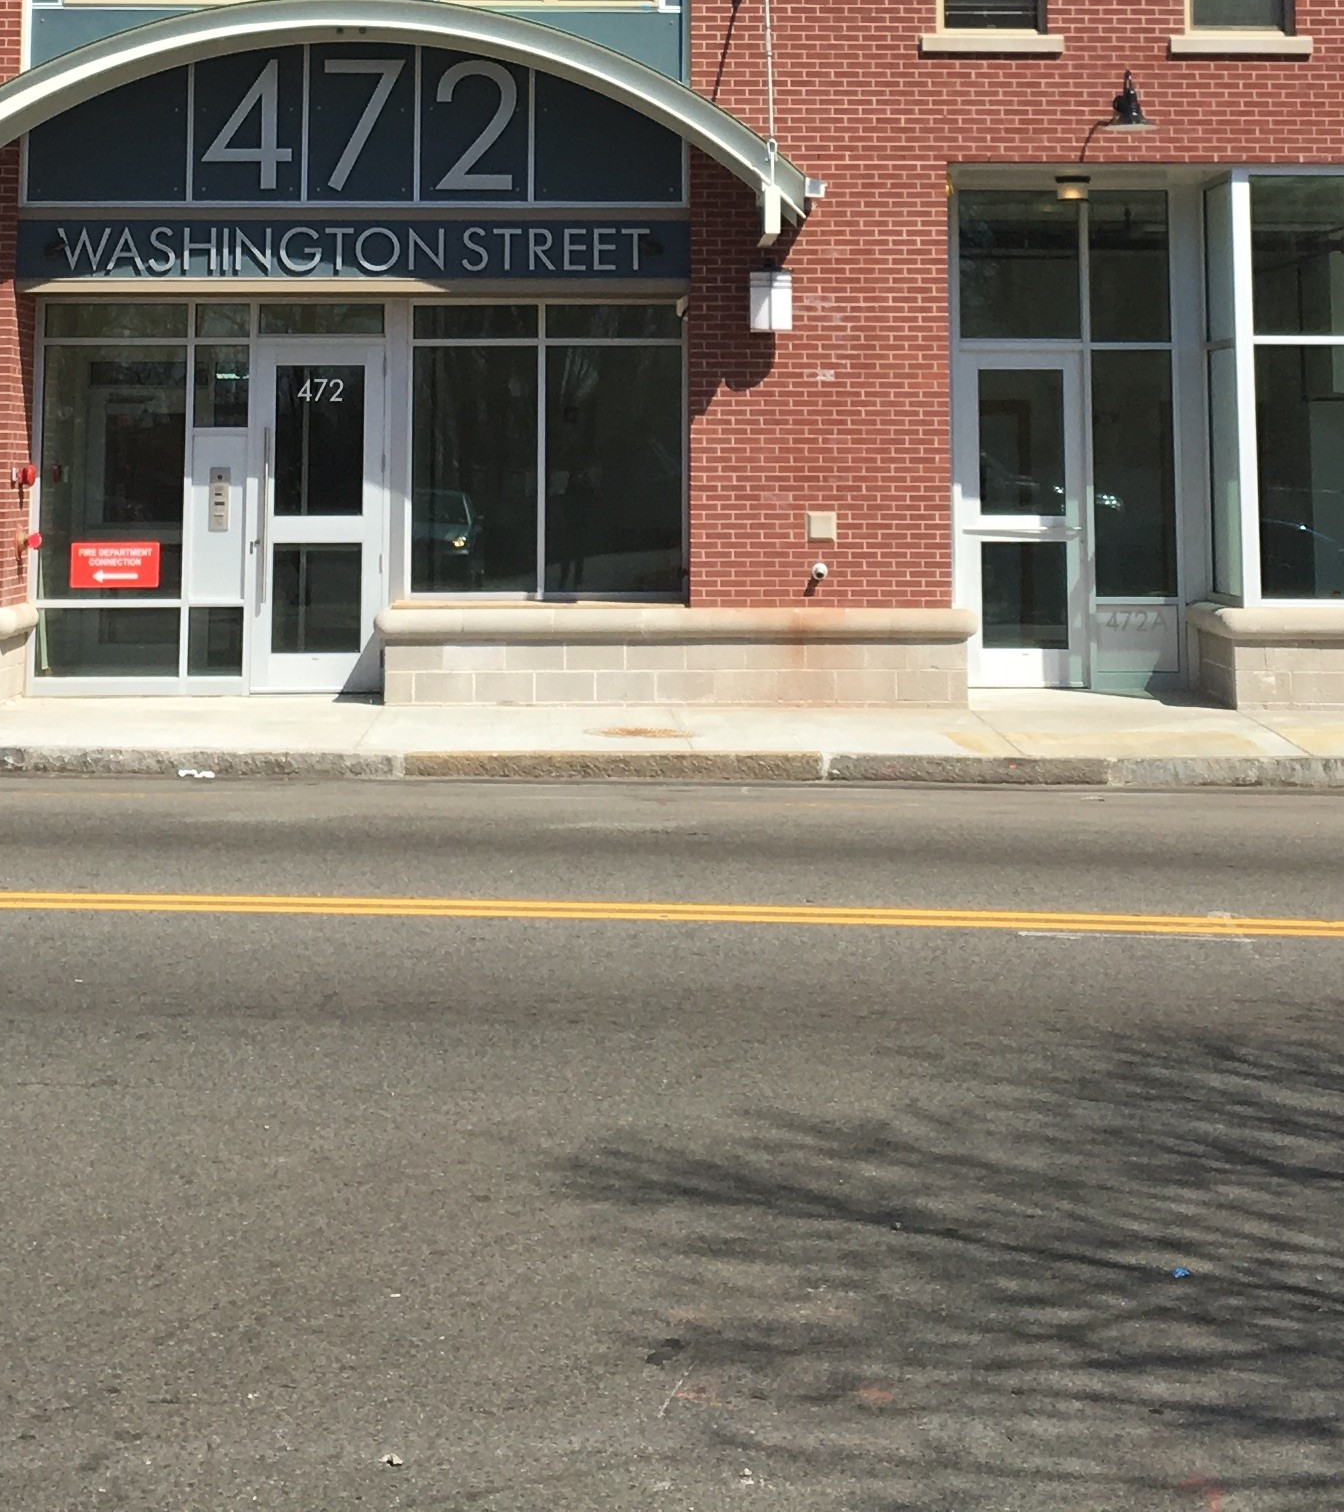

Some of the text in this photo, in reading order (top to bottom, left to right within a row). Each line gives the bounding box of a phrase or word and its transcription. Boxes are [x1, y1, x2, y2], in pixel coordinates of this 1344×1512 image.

[201, 59, 518, 192] 472
[57, 226, 650, 273] WASHINGTON STREET
[297, 378, 344, 402] 472
[78, 547, 153, 557] FIRE DEPARTMENT
[88, 557, 142, 567] CONNECTION
[1105, 610, 1168, 631] 472A
